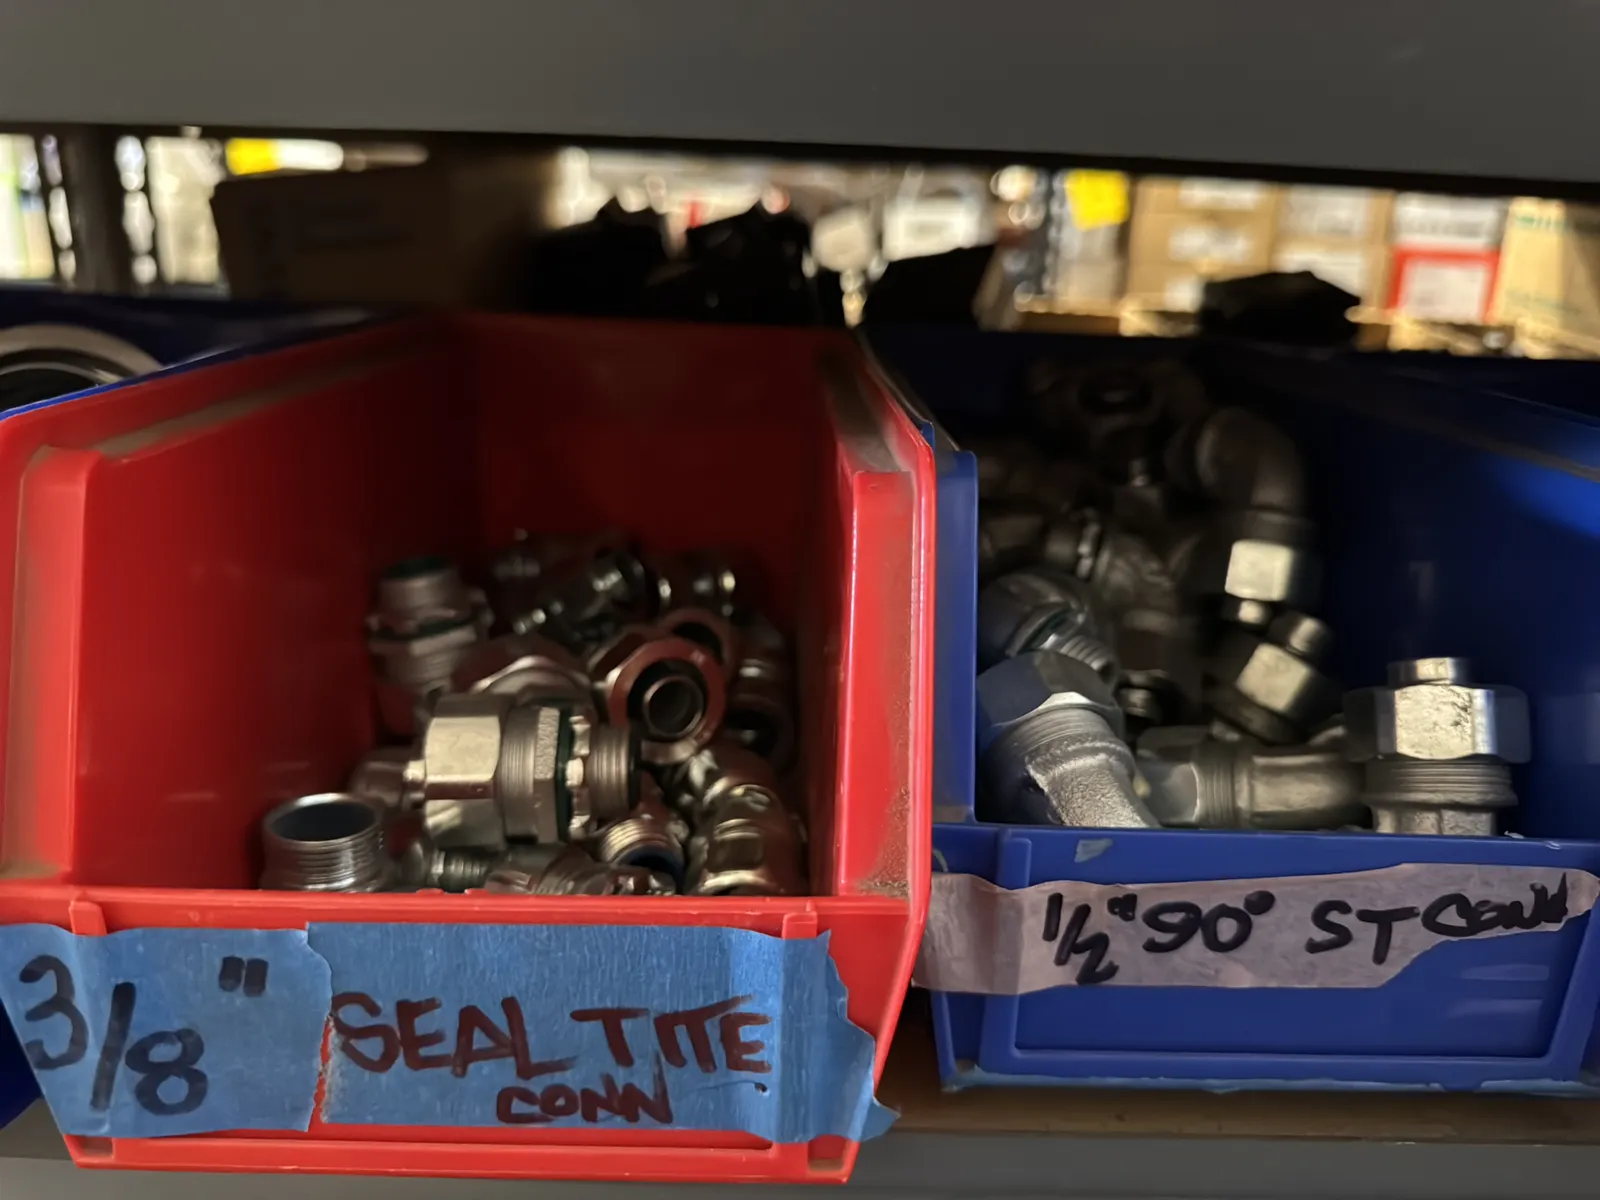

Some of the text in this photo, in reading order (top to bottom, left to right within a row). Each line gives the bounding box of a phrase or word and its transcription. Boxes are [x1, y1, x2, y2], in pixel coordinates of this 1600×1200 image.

[1305, 901, 1420, 965] ST
[331, 991, 578, 1080] SEAL
[570, 994, 773, 1074] TITE
[496, 1050, 674, 1125] CONN
